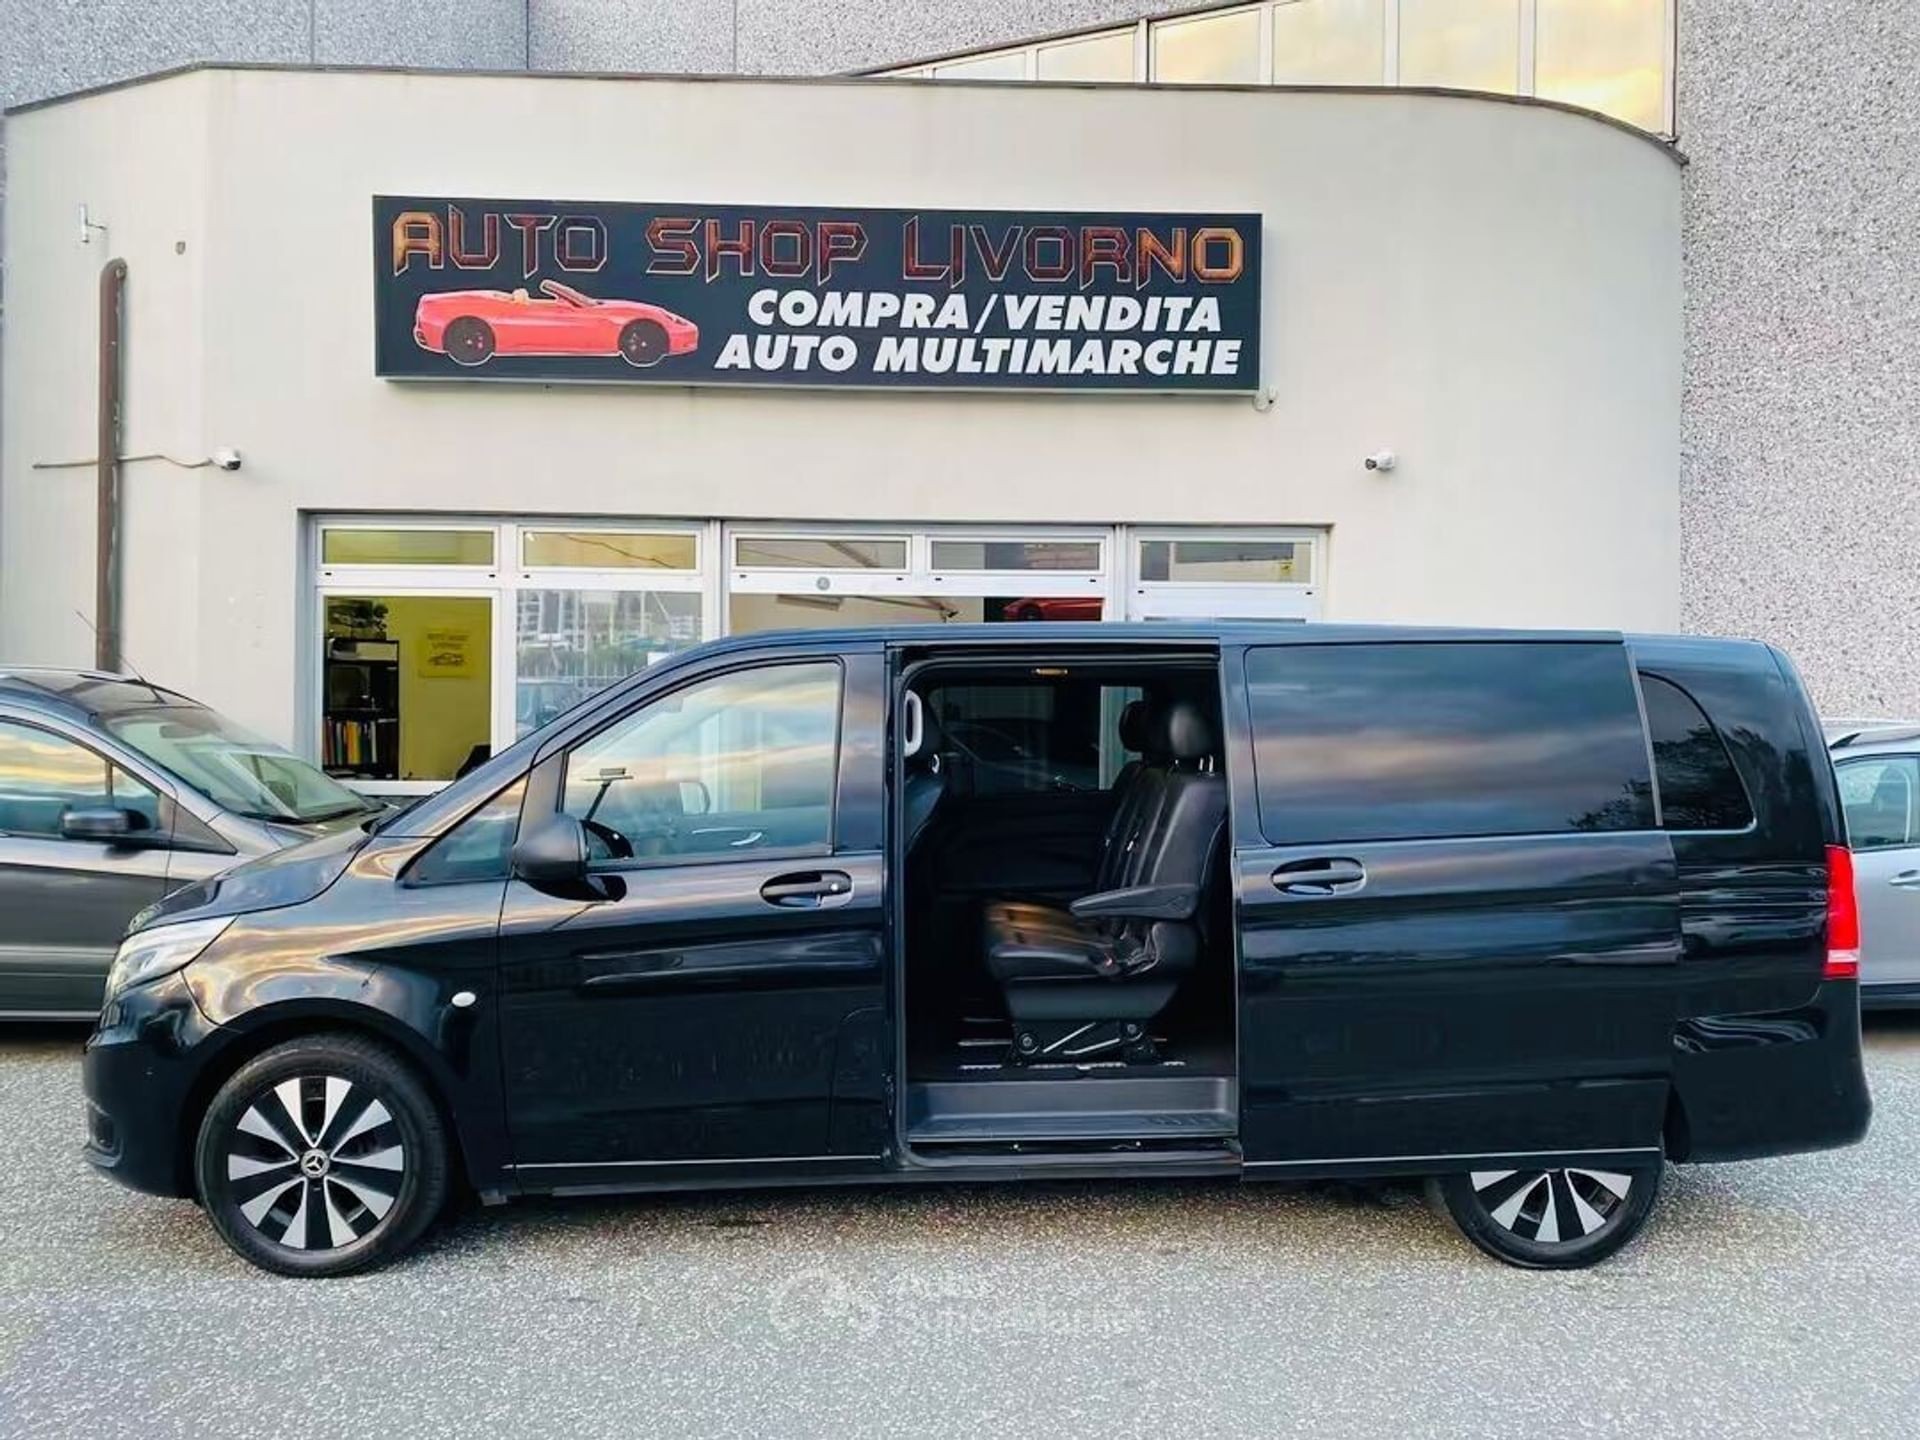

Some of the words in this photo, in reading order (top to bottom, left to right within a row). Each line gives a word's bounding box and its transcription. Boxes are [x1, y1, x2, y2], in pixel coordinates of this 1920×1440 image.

[393, 203, 607, 279] AUTO
[645, 217, 868, 286] SHOP
[903, 216, 1244, 291] LIVORNO
[714, 334, 857, 372] AUTO
[873, 337, 1242, 376] MULTIMARCHE
